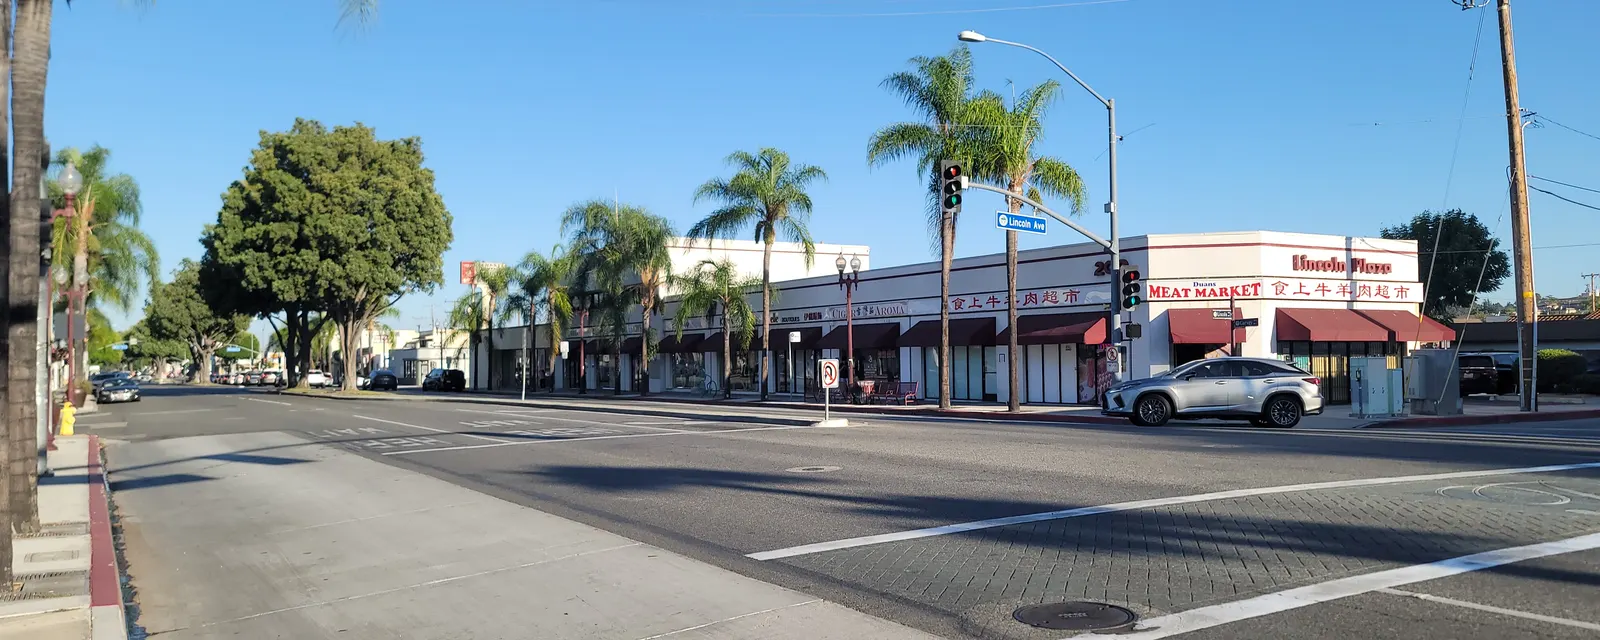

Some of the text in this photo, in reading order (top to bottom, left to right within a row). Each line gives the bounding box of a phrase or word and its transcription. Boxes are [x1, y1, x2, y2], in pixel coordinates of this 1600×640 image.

[1009, 217, 1045, 231] Lincoln Ave
[1292, 254, 1392, 275] Lincoln Plaza
[1149, 282, 1261, 299] MEAT MARKET
[1271, 280, 1410, 299] 食上牛羊肉超市
[832, 307, 856, 319] CIGR
